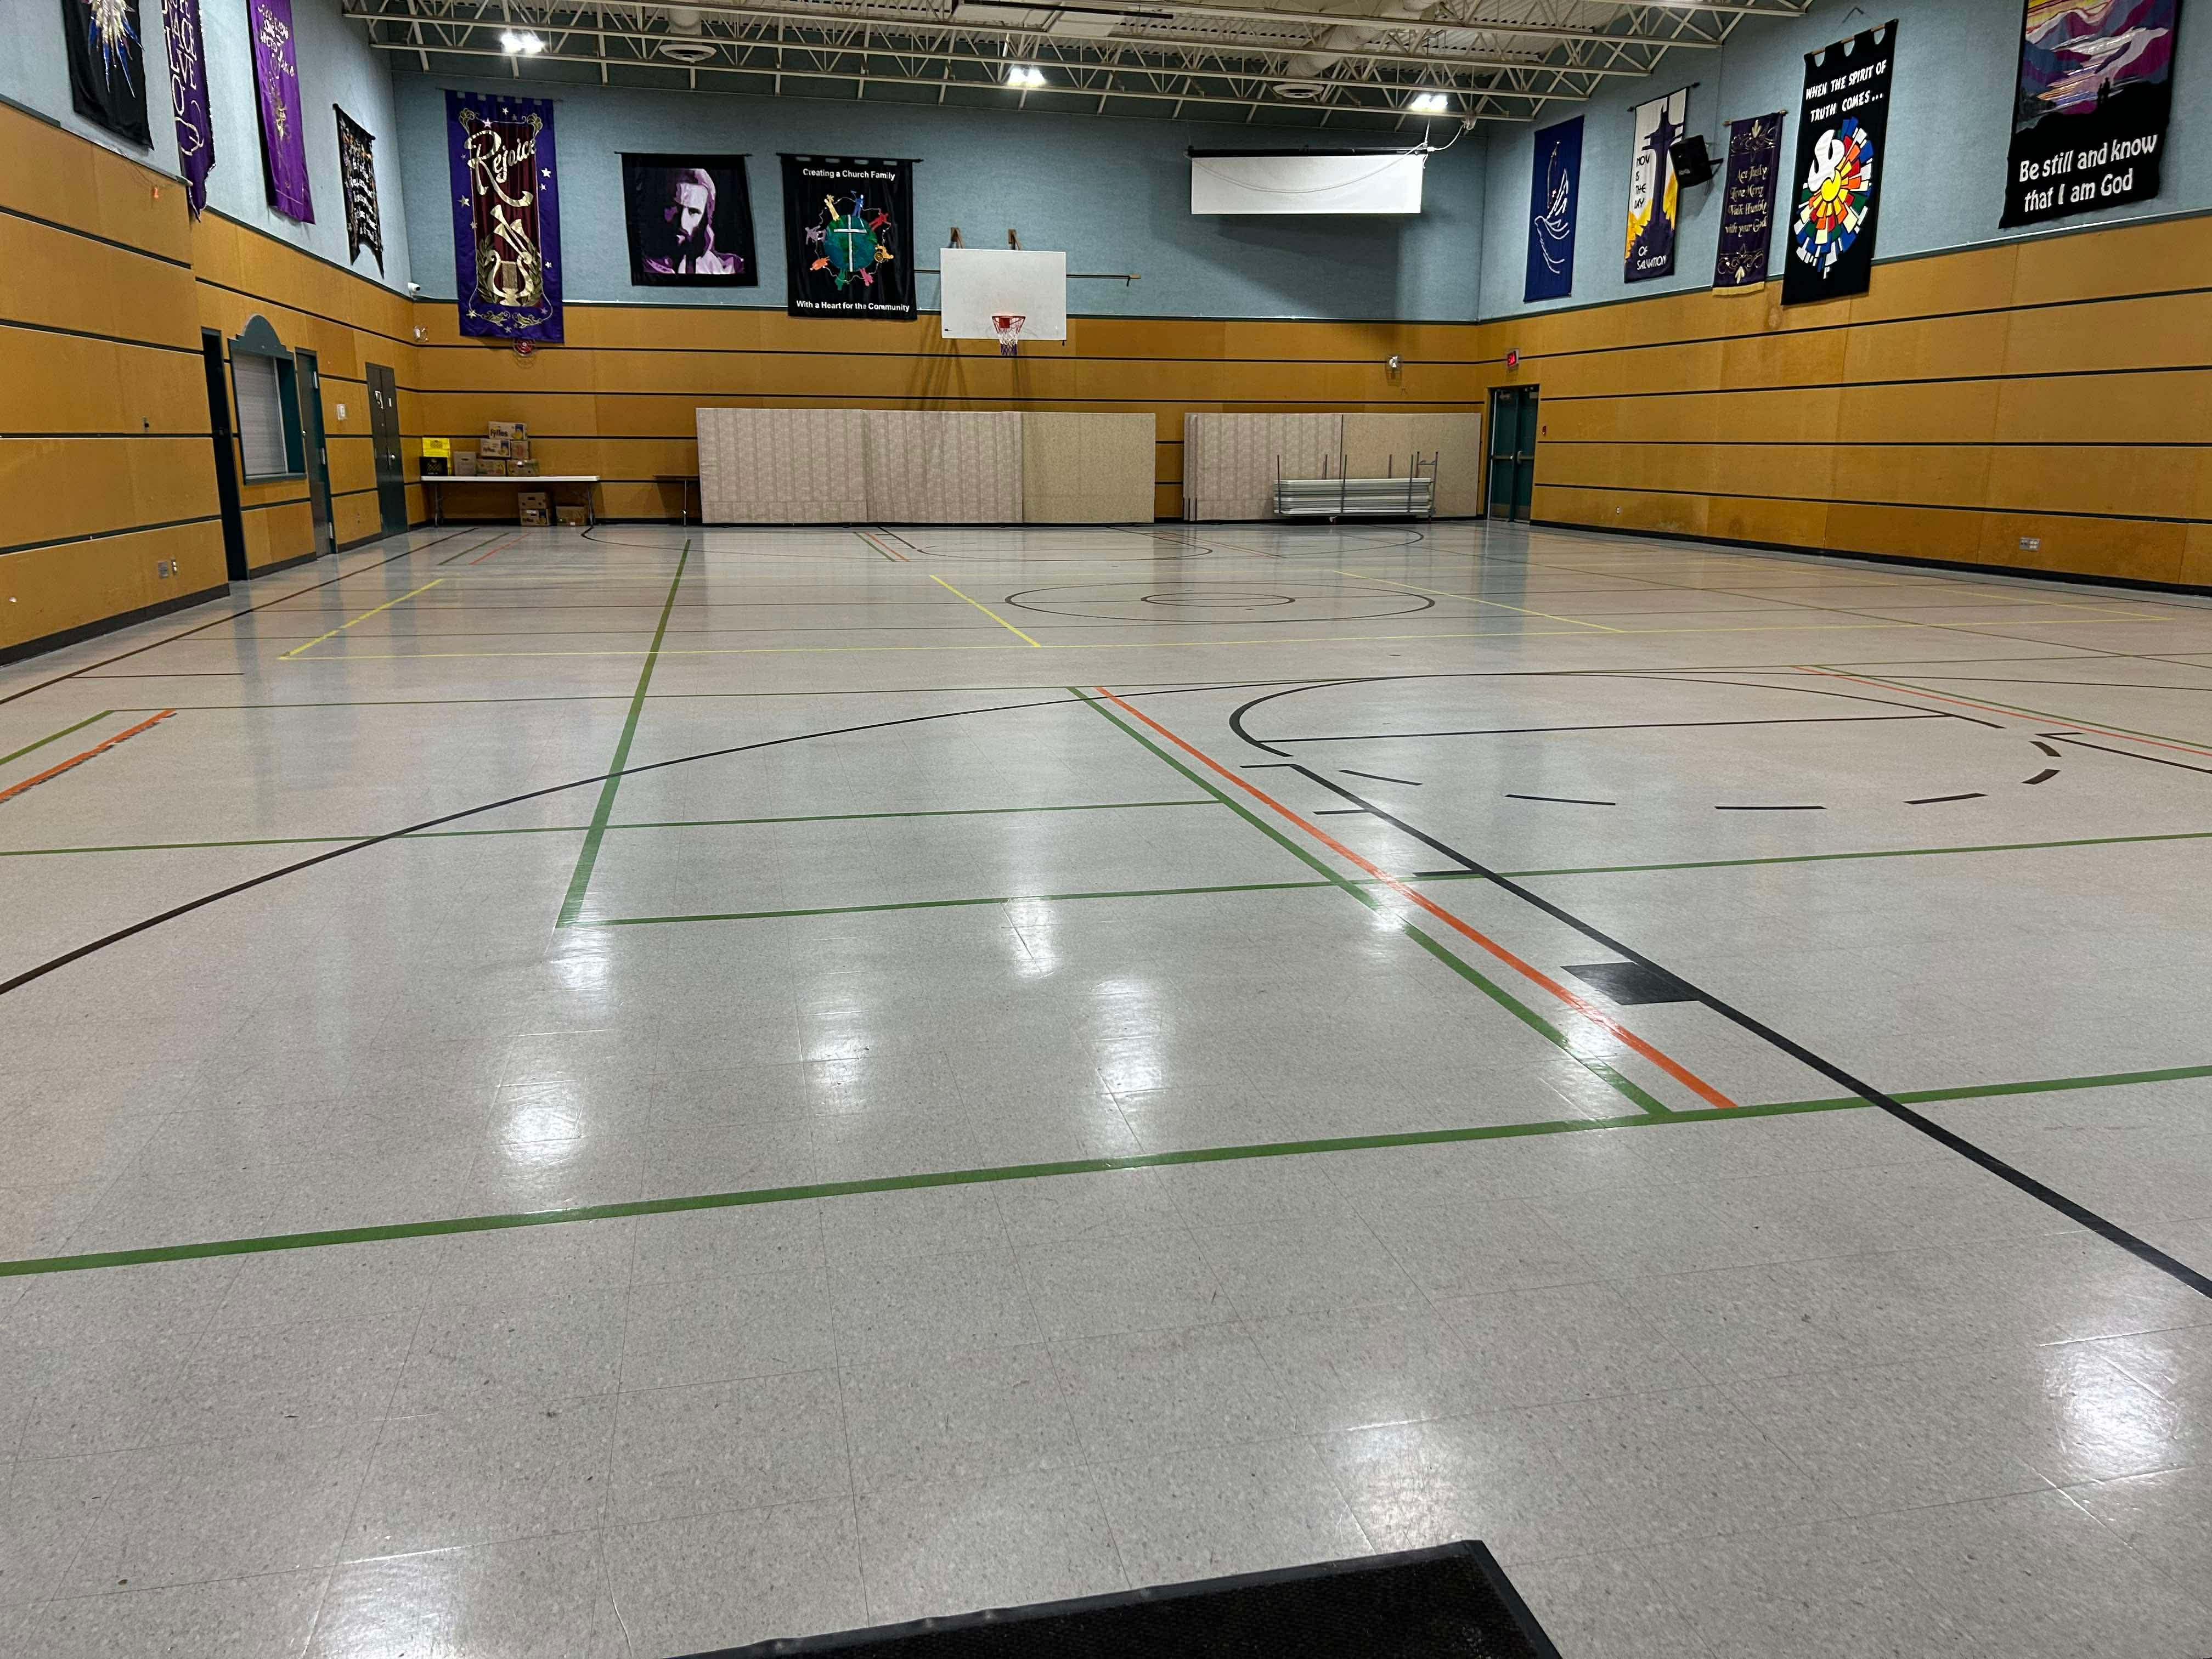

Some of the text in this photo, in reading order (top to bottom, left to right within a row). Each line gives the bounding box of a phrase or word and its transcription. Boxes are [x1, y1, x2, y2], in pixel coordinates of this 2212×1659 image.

[1806, 59, 1887, 100] WHEN THE SPIRIT OF
[1810, 103, 1837, 122] TRUTH
[2019, 134, 2158, 182] Be still and know
[464, 130, 536, 207] Rejoice
[803, 168, 834, 178] Creating
[871, 171, 895, 181] Family
[1635, 183, 1646, 194] THE
[2024, 168, 2133, 212] that I am God
[1753, 216, 1767, 232] God
[1638, 246, 1647, 256] OF
[868, 303, 910, 312] Community
